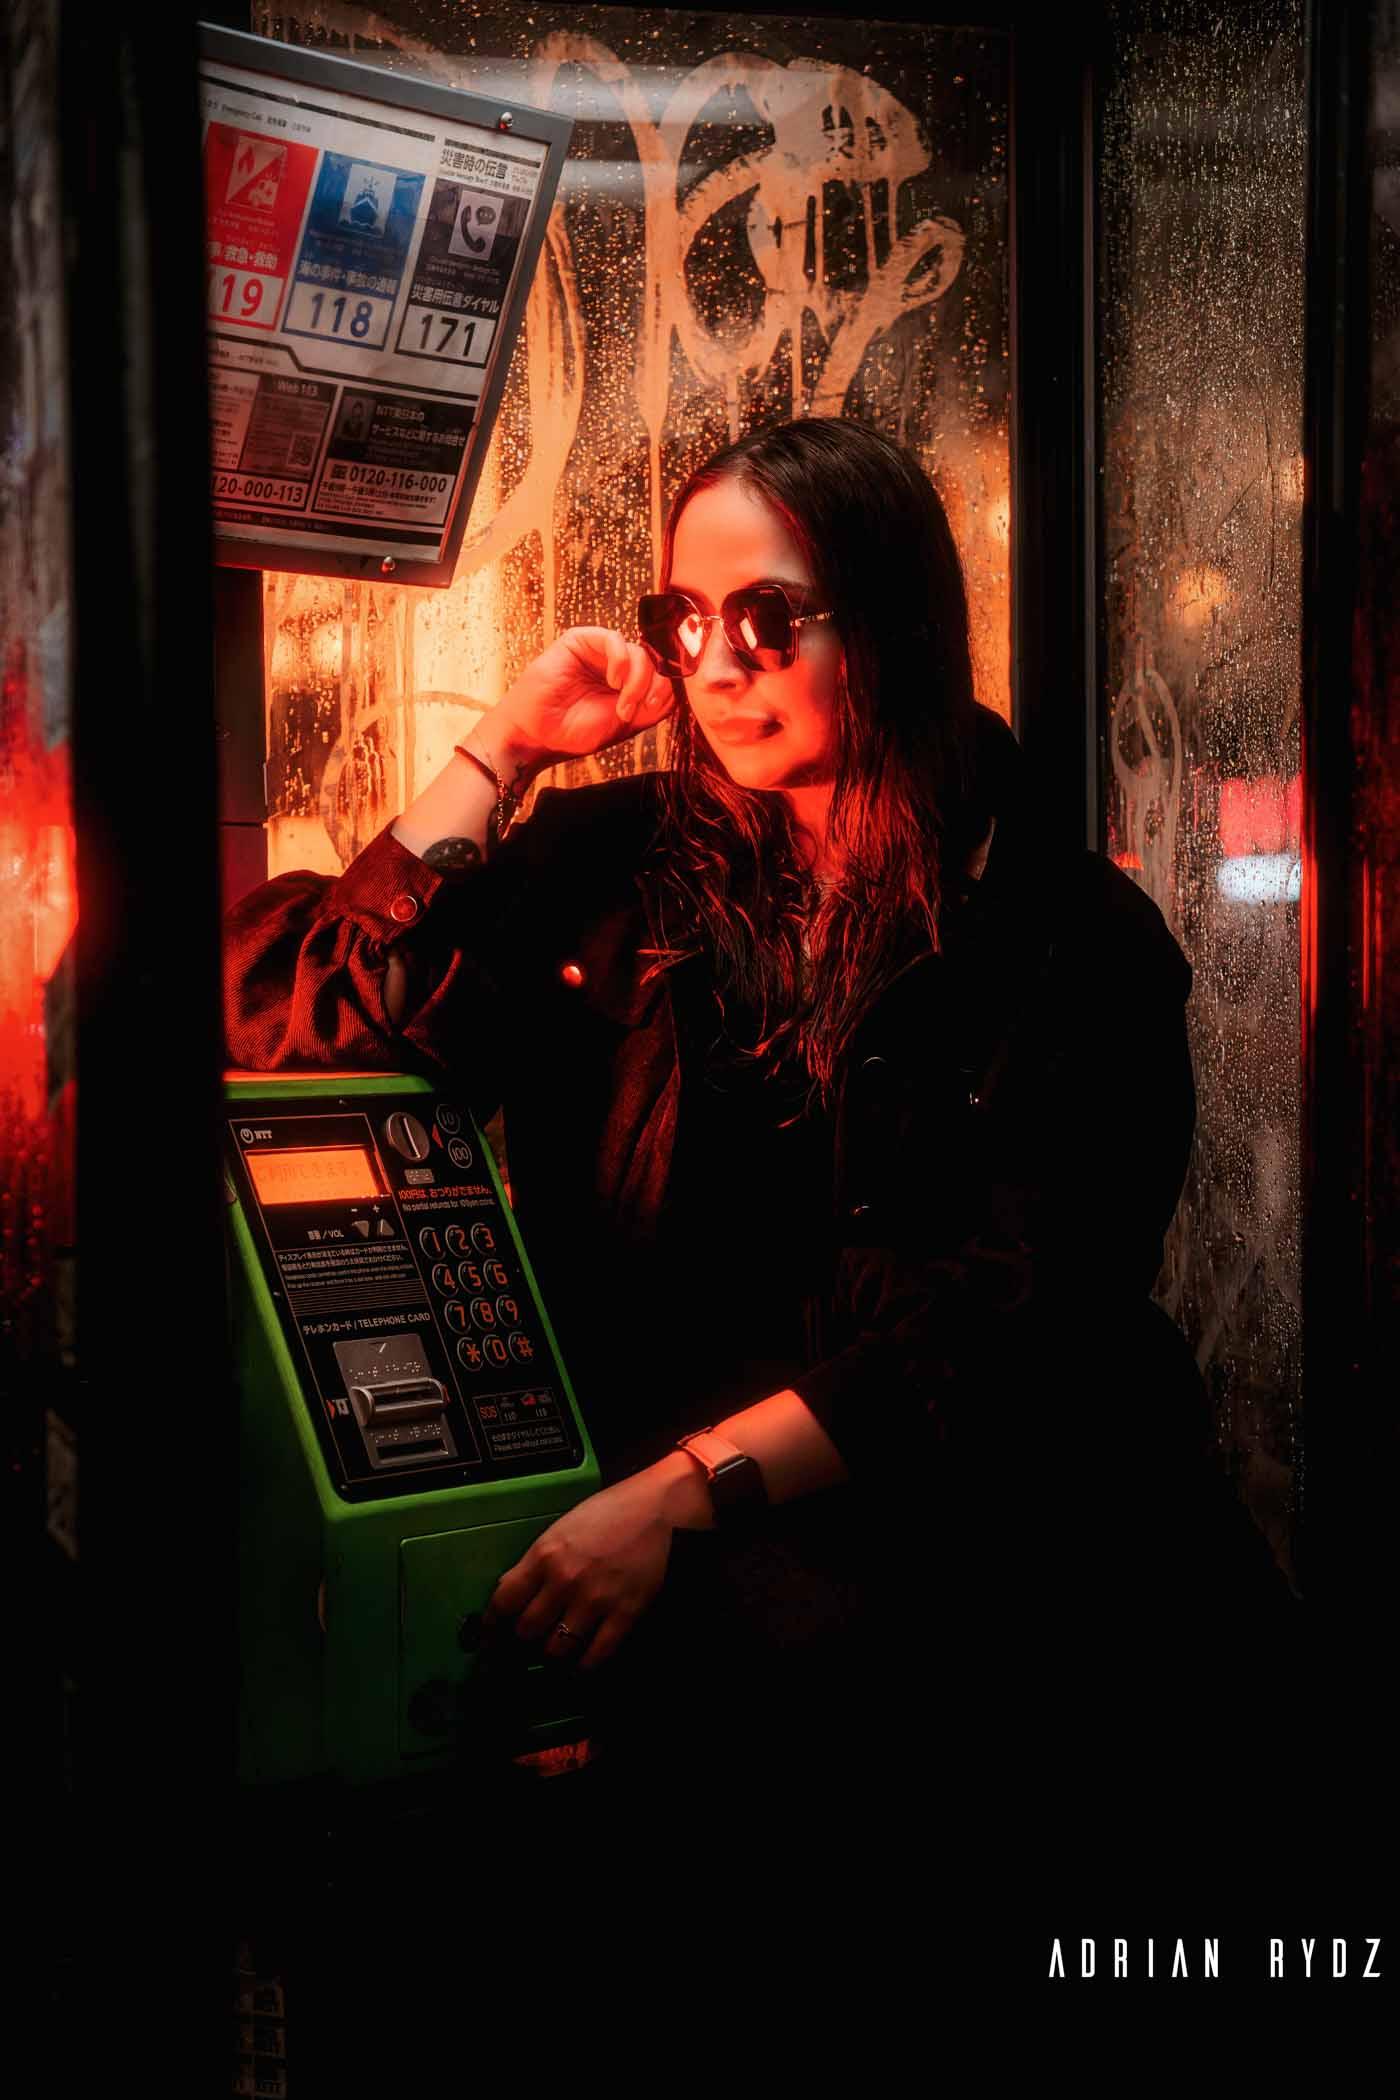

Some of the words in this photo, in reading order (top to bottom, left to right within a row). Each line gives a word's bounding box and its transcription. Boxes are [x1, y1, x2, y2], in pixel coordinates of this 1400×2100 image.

[440, 148, 508, 179] 災害時の伝言
[207, 273, 264, 317] 19
[311, 293, 373, 338] 118
[419, 314, 476, 357] 171
[207, 476, 303, 503] 120-000-113
[350, 466, 447, 492] 0120-116-000
[431, 1231, 441, 1252] 1
[455, 1228, 471, 1250] 2
[479, 1227, 496, 1249] 3
[443, 1267, 456, 1289] 4
[467, 1265, 482, 1287] 5
[492, 1263, 508, 1286] 6
[359, 1314, 407, 1330] TELEPHONE
[407, 1311, 431, 1324] CARD
[453, 1304, 466, 1329] 7
[479, 1301, 495, 1323] 8
[503, 1298, 519, 1321] 9
